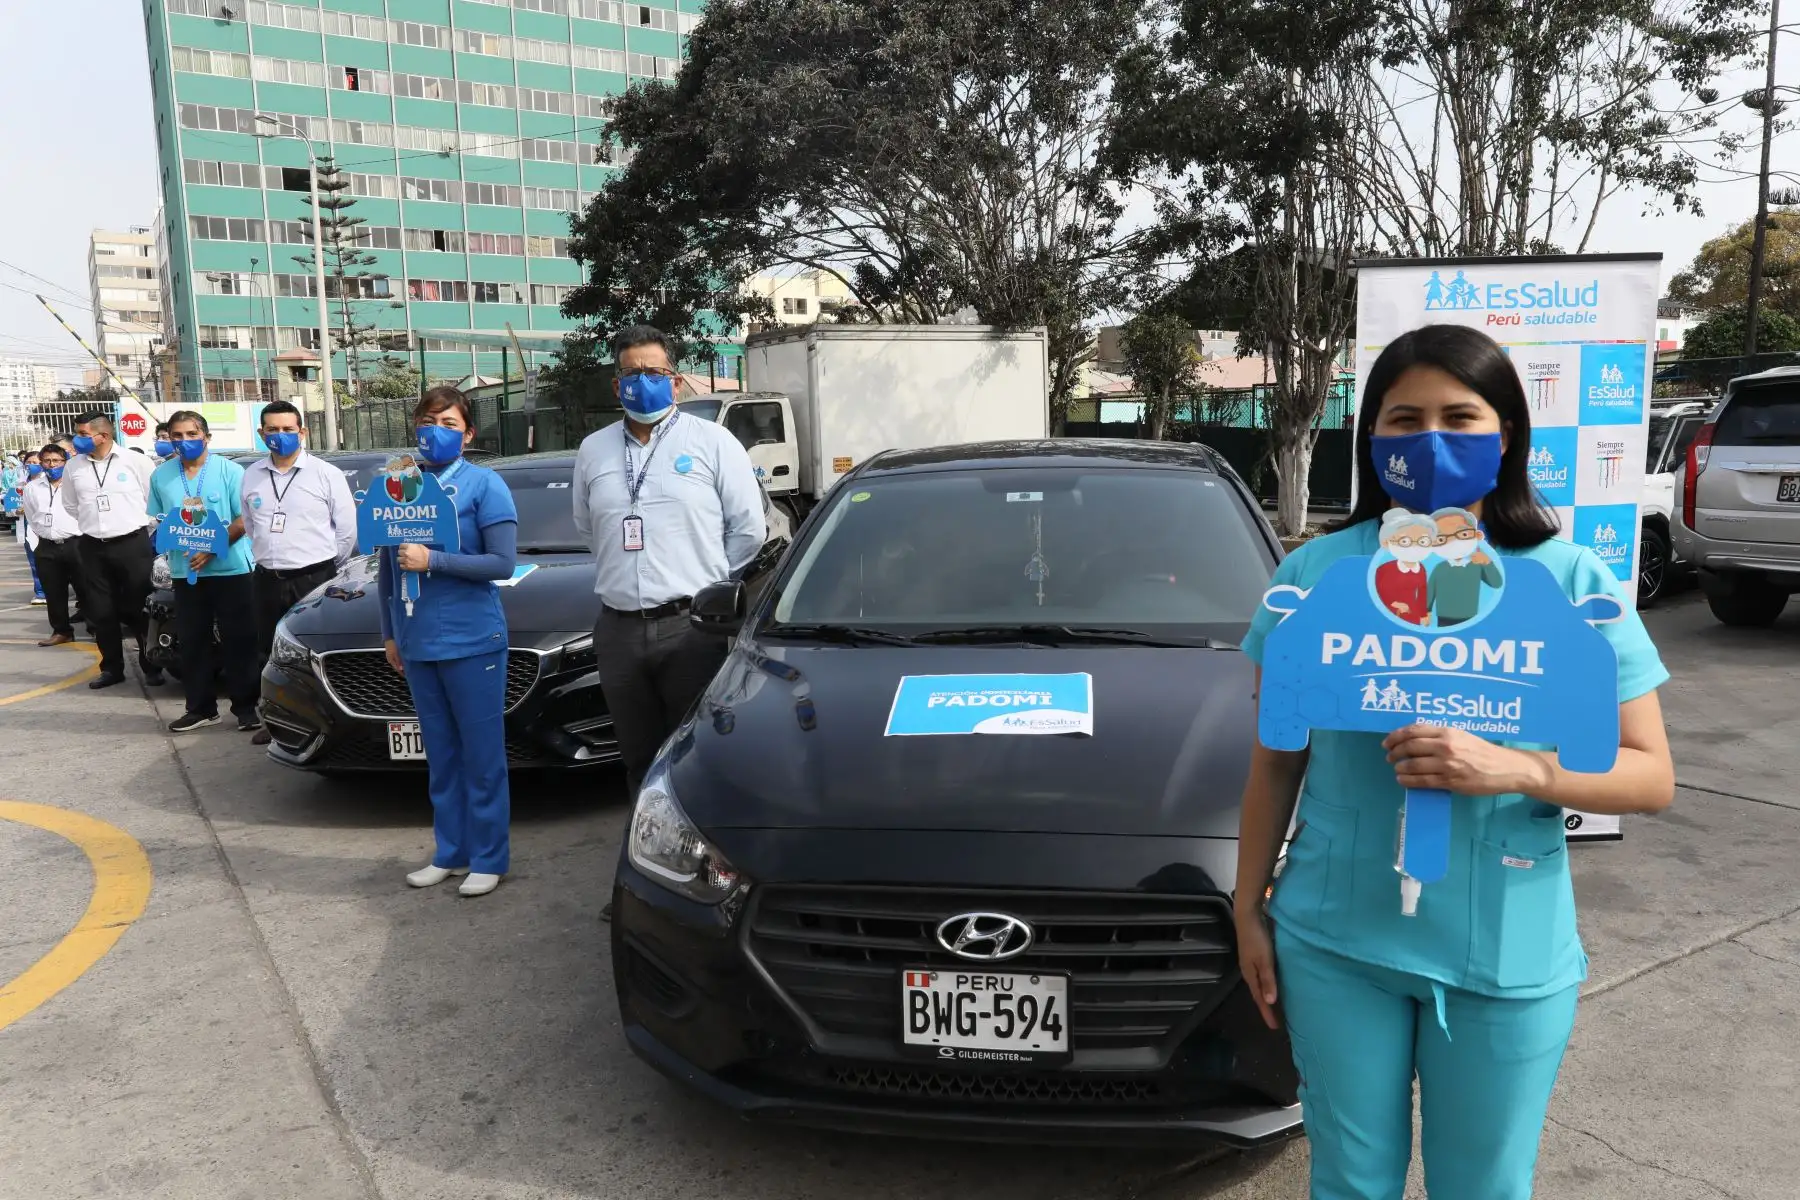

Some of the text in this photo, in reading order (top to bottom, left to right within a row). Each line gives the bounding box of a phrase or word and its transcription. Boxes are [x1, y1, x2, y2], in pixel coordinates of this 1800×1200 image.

[1487, 279, 1598, 309] EsSalud
[1486, 311, 1597, 326] Perú saludable
[1527, 362, 1560, 371] Siempre
[1588, 384, 1635, 399] EsSalud
[120, 420, 145, 430] PARE
[1596, 441, 1624, 450] Siempre
[1529, 466, 1567, 481] Salud
[373, 505, 438, 520] PADOMI
[169, 525, 216, 538] PADOMI
[403, 527, 434, 537] EsSalud
[1594, 543, 1627, 557] Salud
[1321, 632, 1544, 675] PADOMI
[927, 694, 1053, 708] PADOMI
[1415, 692, 1521, 720] EsSalud
[1451, 719, 1520, 734] saludable
[956, 975, 1014, 991] PERU
[909, 989, 1063, 1041] BWG-594
[958, 1050, 1019, 1061] GILDEMEISTER
